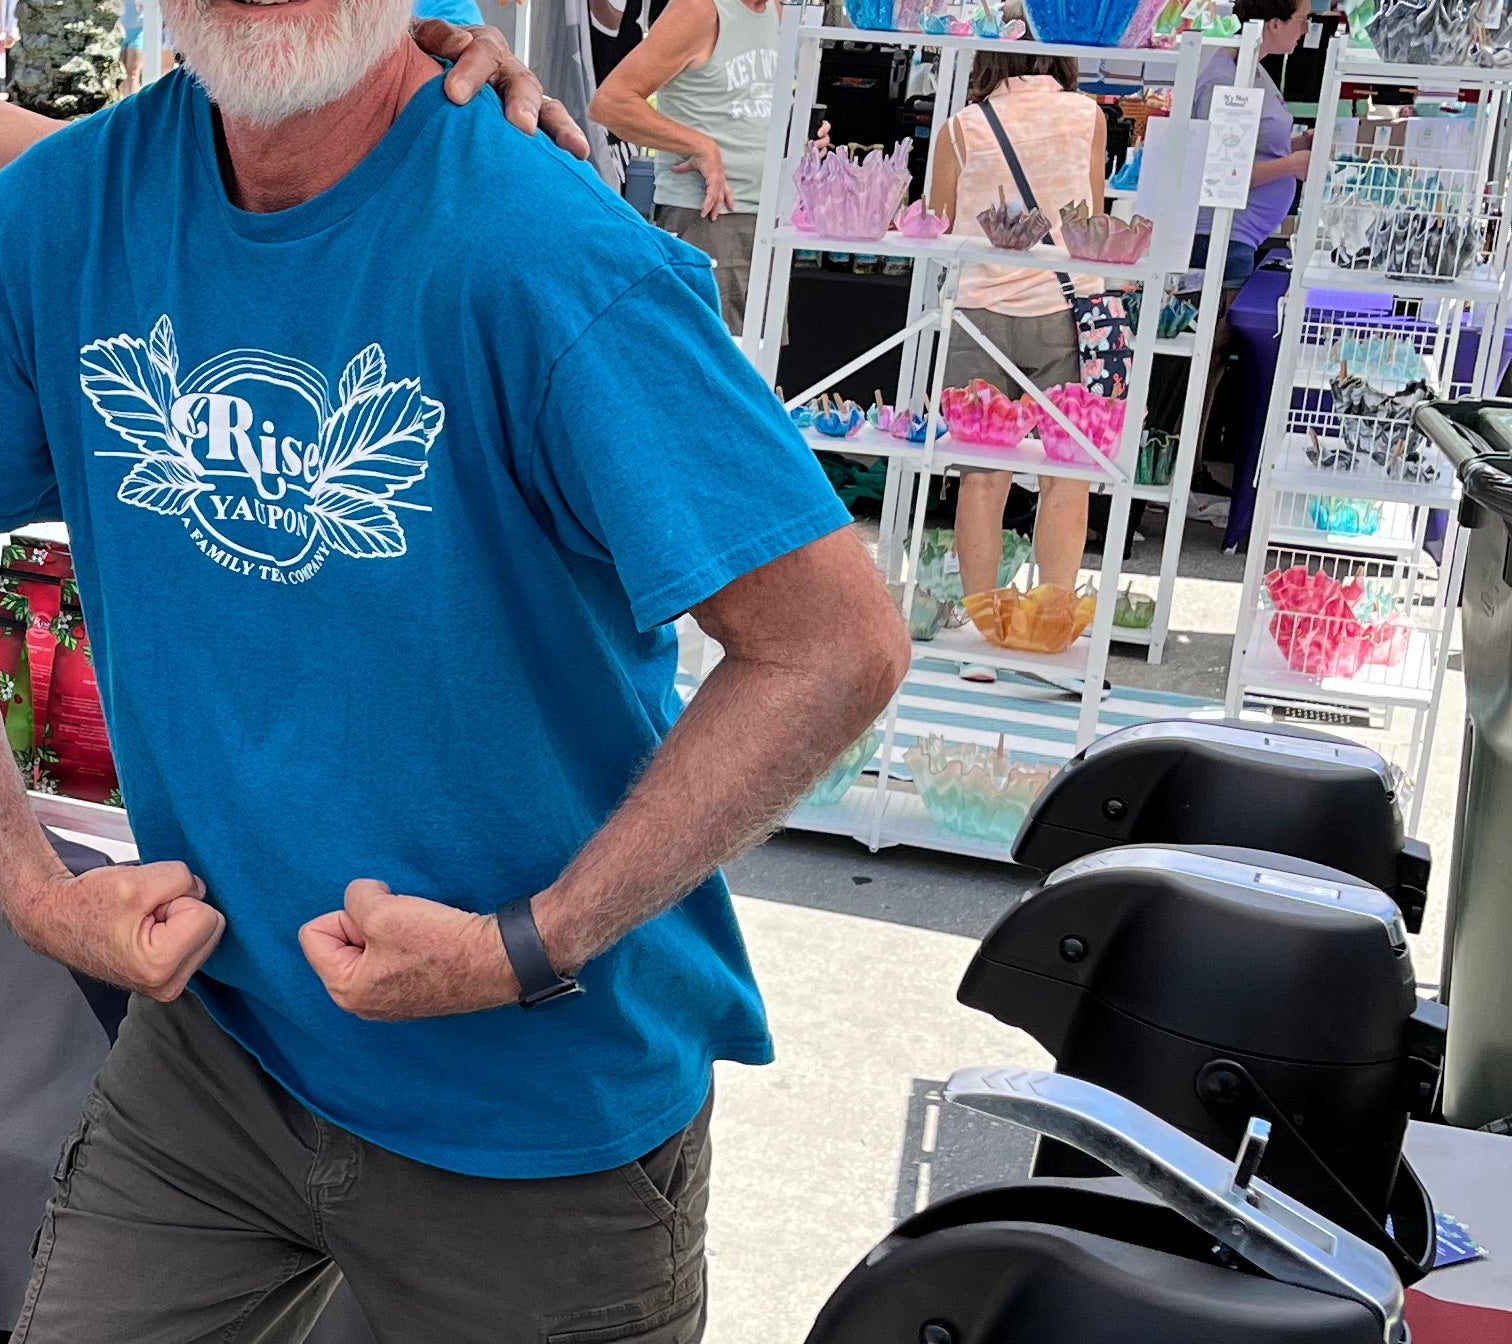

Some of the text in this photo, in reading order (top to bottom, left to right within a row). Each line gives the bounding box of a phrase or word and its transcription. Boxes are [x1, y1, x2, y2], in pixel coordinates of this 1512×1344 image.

[725, 49, 756, 92] KEY
[171, 391, 321, 500] Rise
[209, 494, 309, 539] YAUPON
[181, 516, 191, 530] A
[190, 527, 256, 577] FAMILY
[288, 541, 332, 586] COMPANY
